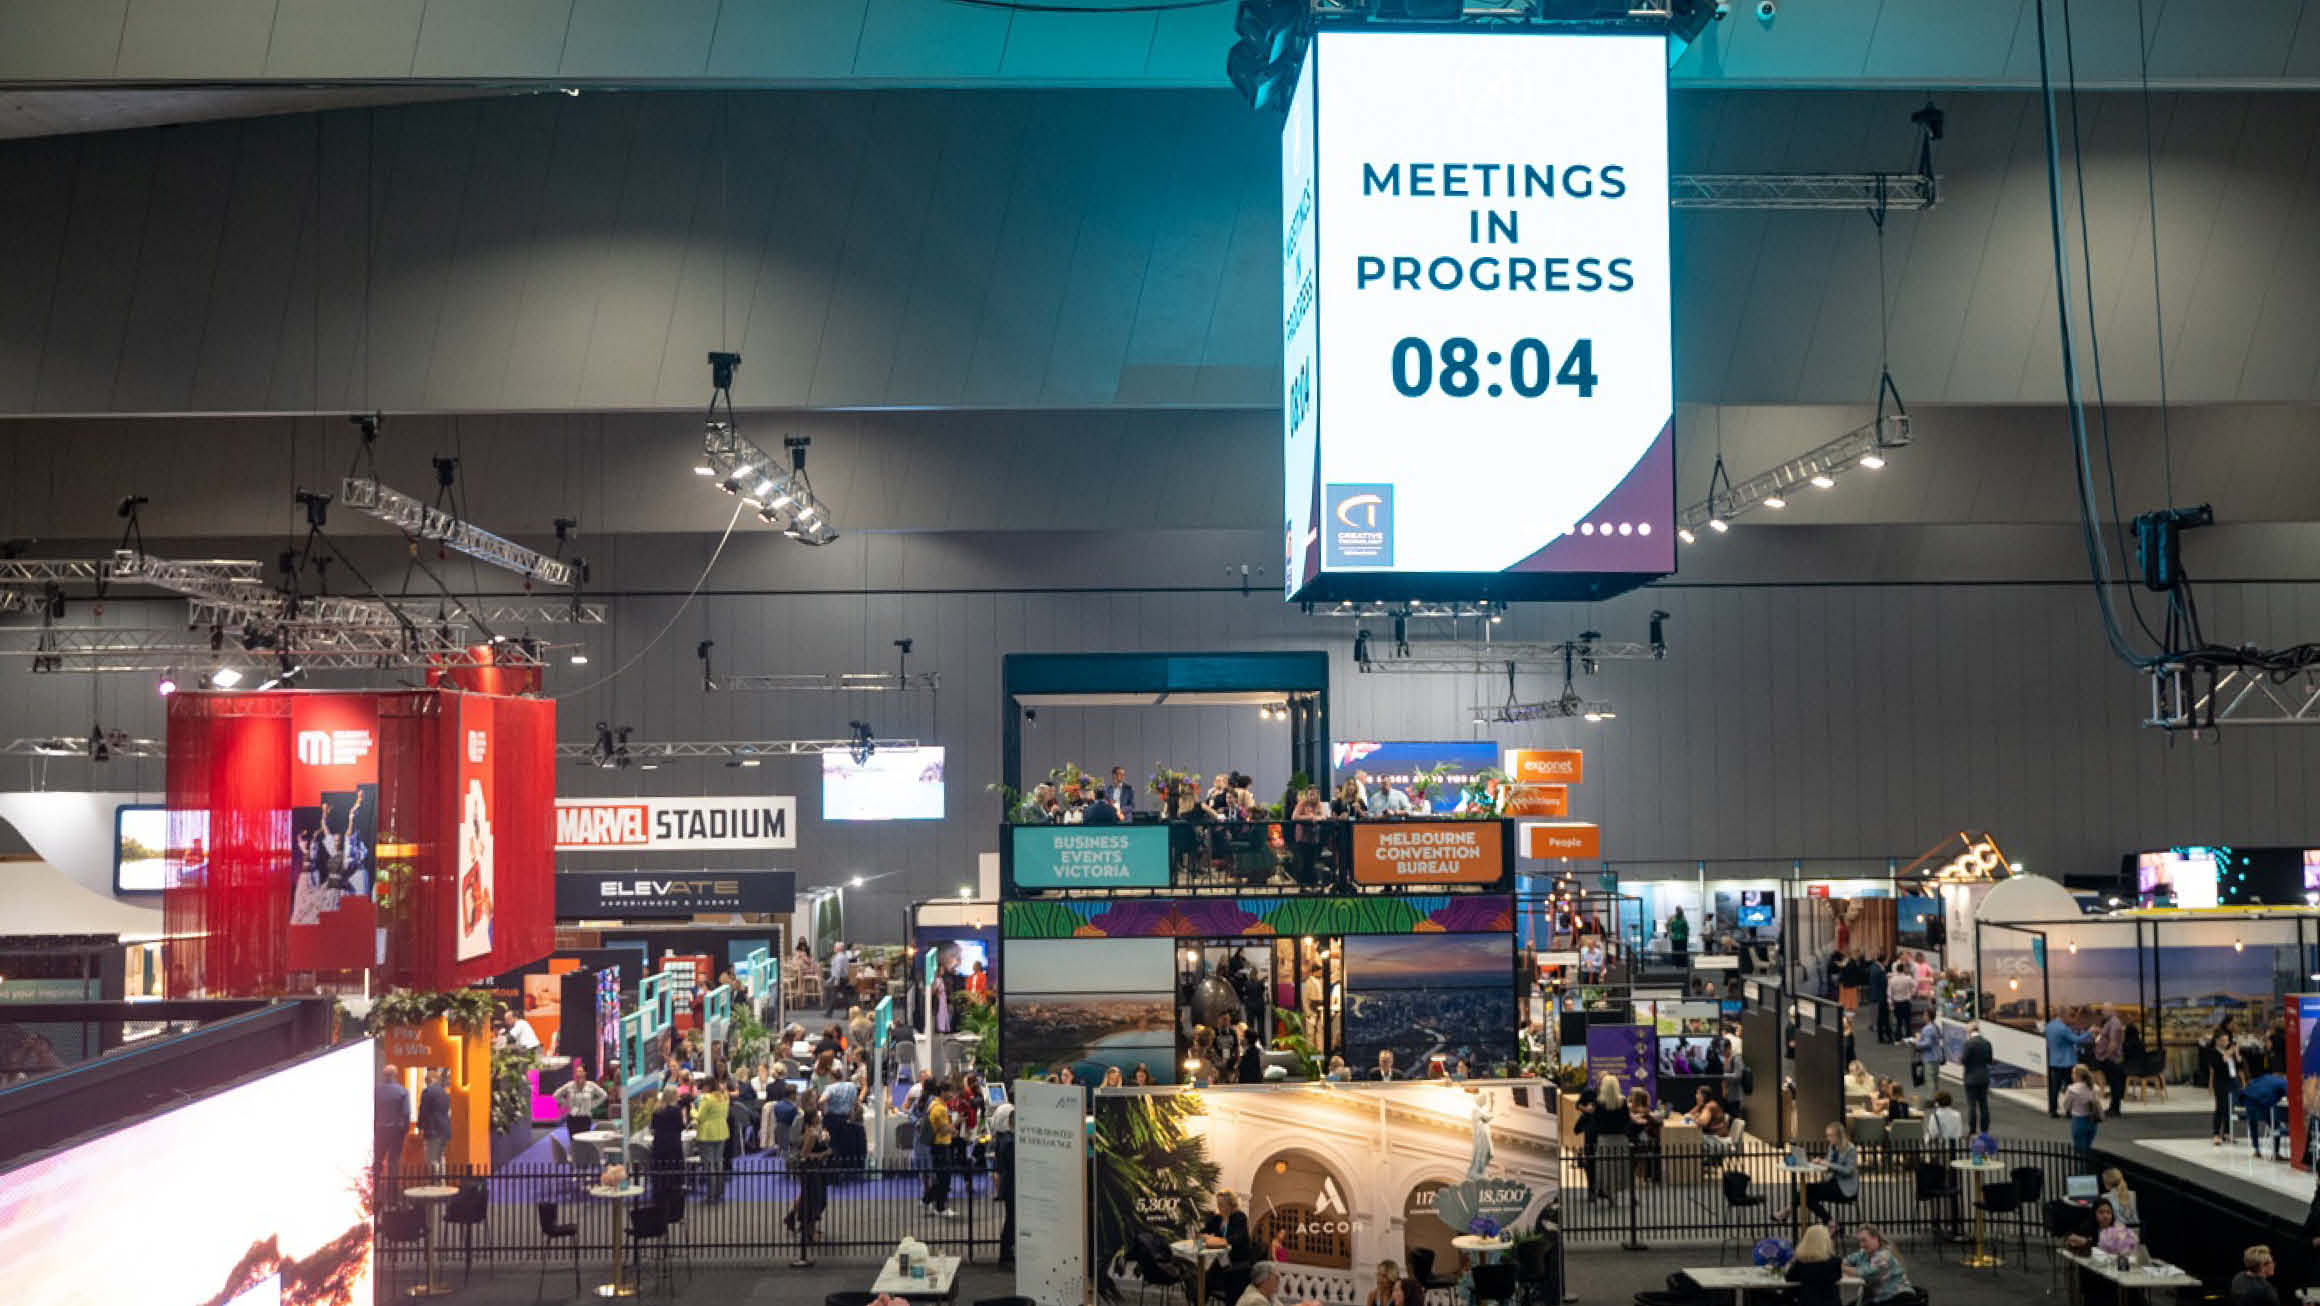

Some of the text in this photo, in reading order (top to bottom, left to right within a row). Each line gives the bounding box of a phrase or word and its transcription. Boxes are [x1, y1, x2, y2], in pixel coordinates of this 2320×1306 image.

[1363, 163, 1626, 199] MEETINGS
[1470, 210, 1518, 244] IN
[1357, 256, 1634, 292] PROGRESS
[1392, 336, 1598, 398] 08:04
[1523, 760, 1573, 772] exponet
[556, 806, 785, 844] MARVEL STADIUM
[1054, 835, 1129, 849] BUSINESS
[1380, 831, 1476, 846] MELBOURNE
[1549, 837, 1583, 849] People
[1061, 850, 1123, 863] EVENTS
[1375, 847, 1480, 860] CONVENTION
[1053, 864, 1130, 878] VICTORIA
[1396, 861, 1459, 875] BUREAU
[601, 880, 739, 896] ELEVATE
[1295, 1221, 1364, 1234] ACCOR
